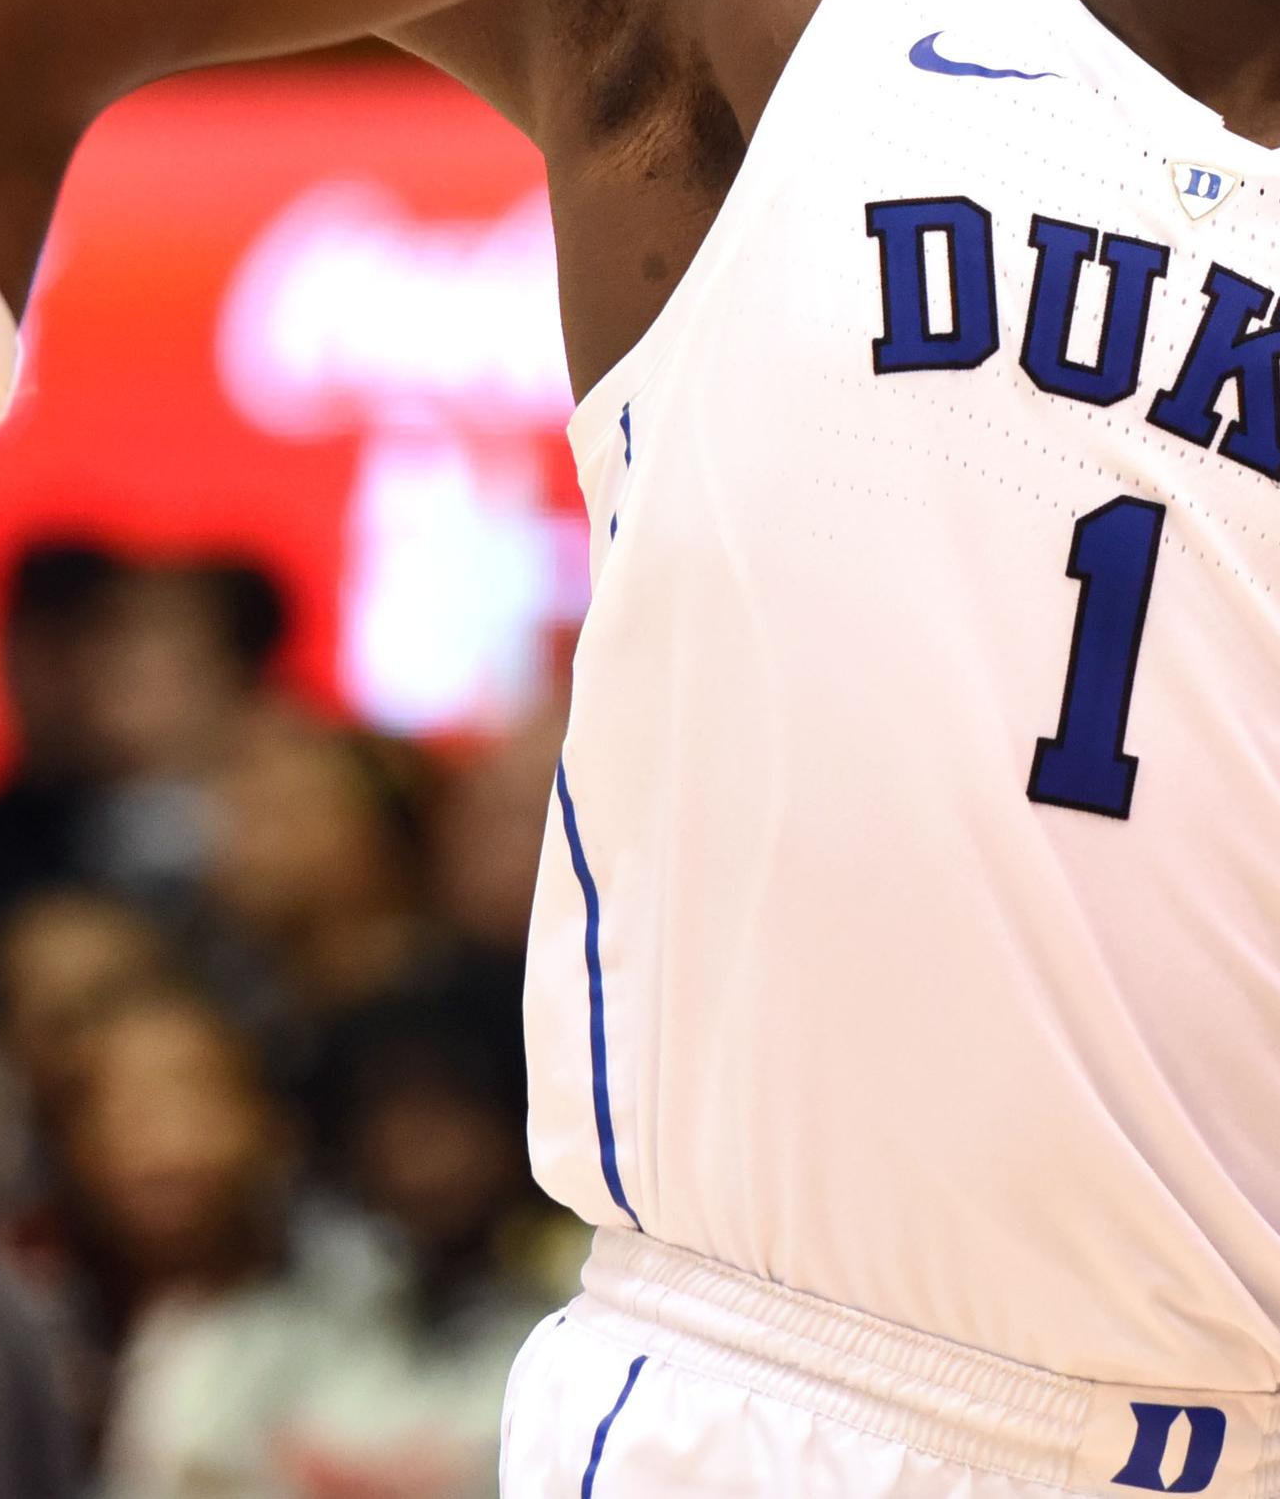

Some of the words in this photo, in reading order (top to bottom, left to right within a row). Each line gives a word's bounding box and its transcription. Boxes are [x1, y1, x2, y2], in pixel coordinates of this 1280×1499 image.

[1182, 168, 1221, 200] D
[1026, 495, 1167, 820] 1
[1110, 1402, 1227, 1493] D
